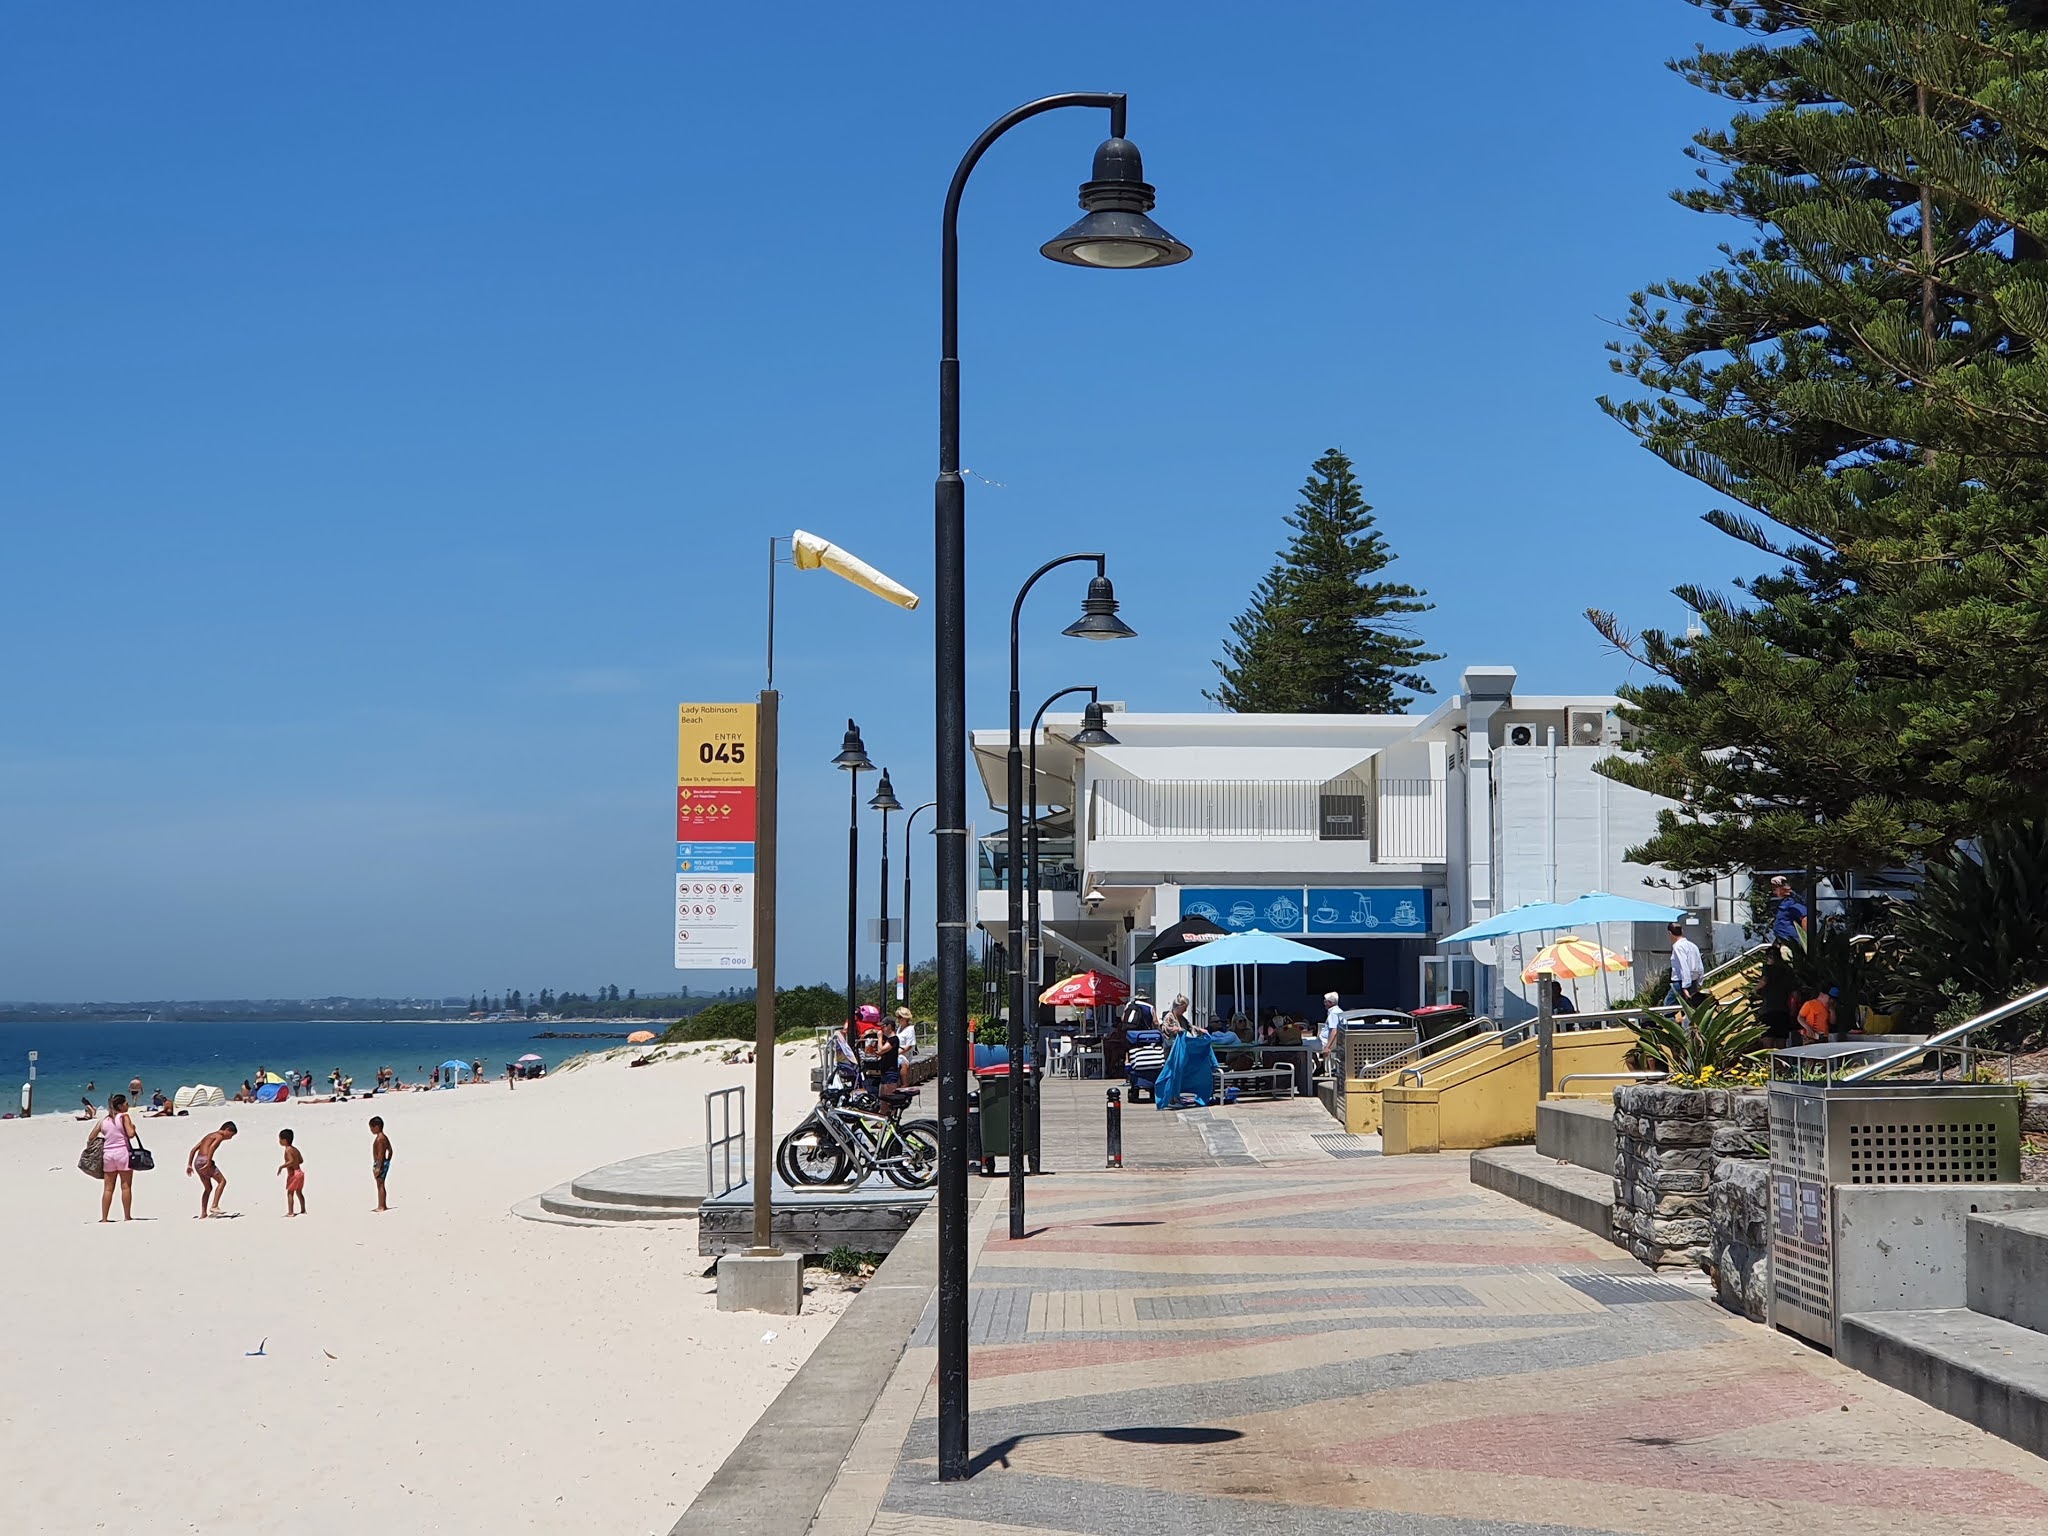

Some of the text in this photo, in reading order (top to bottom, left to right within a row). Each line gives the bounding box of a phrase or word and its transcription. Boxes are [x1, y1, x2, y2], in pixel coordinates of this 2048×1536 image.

[681, 706, 738, 715] Lady Robinsons
[681, 716, 703, 724] Beach
[715, 733, 742, 741] ENTRY
[699, 742, 745, 764] 045
